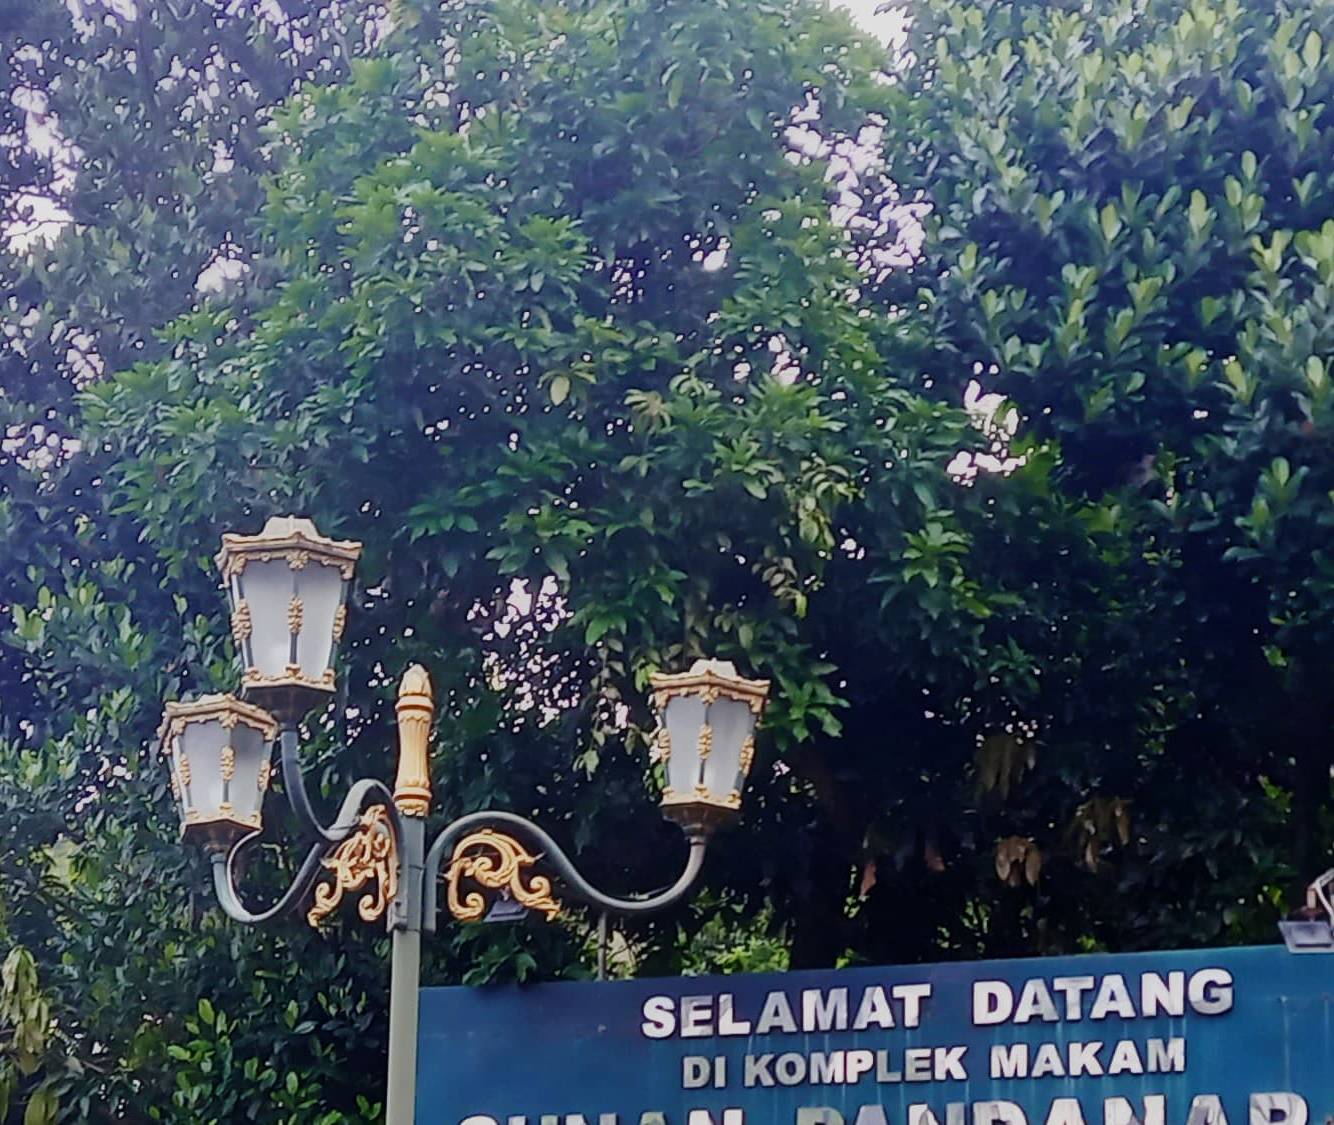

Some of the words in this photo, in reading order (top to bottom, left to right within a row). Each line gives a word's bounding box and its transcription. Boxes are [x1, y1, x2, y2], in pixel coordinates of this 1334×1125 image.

[640, 983, 933, 1039] SELAMAT
[971, 967, 1235, 1026] DATANG
[681, 1055, 727, 1089] DI
[743, 1046, 969, 1087] KOMPLEK
[989, 1037, 1187, 1080] MAKAM
